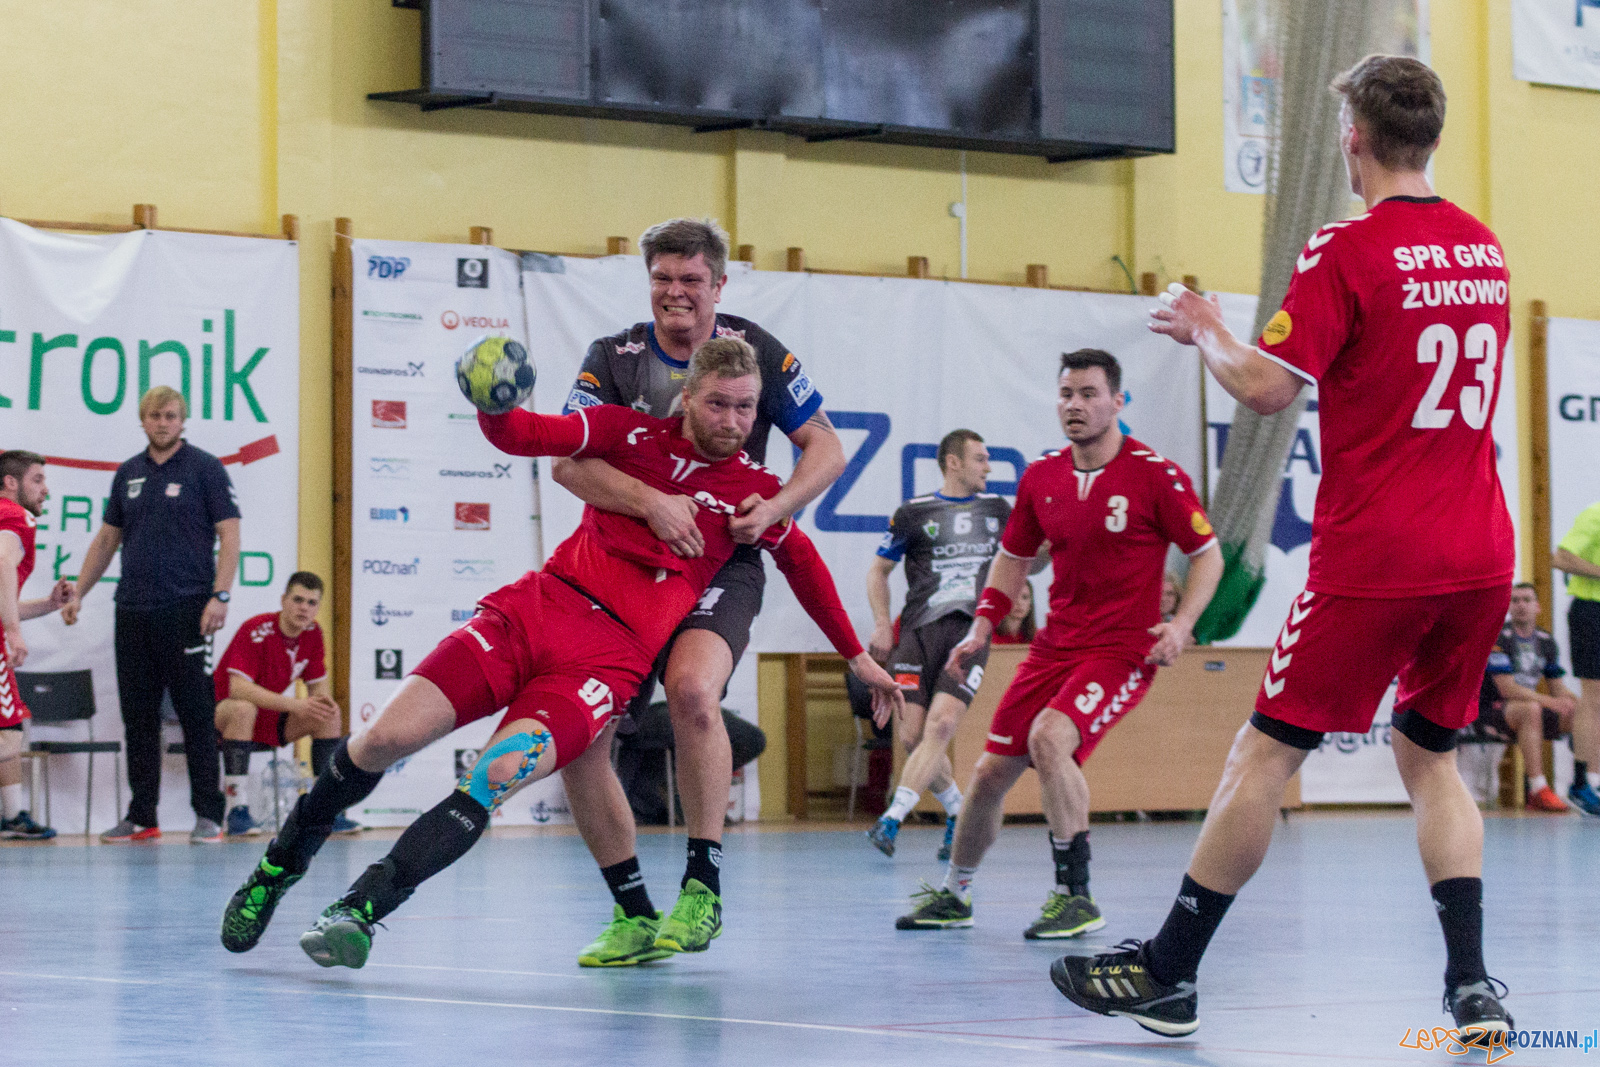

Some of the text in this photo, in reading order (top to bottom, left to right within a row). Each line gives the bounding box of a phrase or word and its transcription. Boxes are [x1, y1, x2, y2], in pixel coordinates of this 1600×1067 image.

[1393, 243, 1504, 272] SPR GKS
[1402, 277, 1508, 310] ŻUKOWO
[462, 316, 510, 329] VEOLIA
[1410, 322, 1499, 431] 23
[953, 511, 973, 536] 6
[1105, 495, 1129, 533] 3
[966, 664, 985, 691] 6
[1074, 681, 1105, 714] 3
